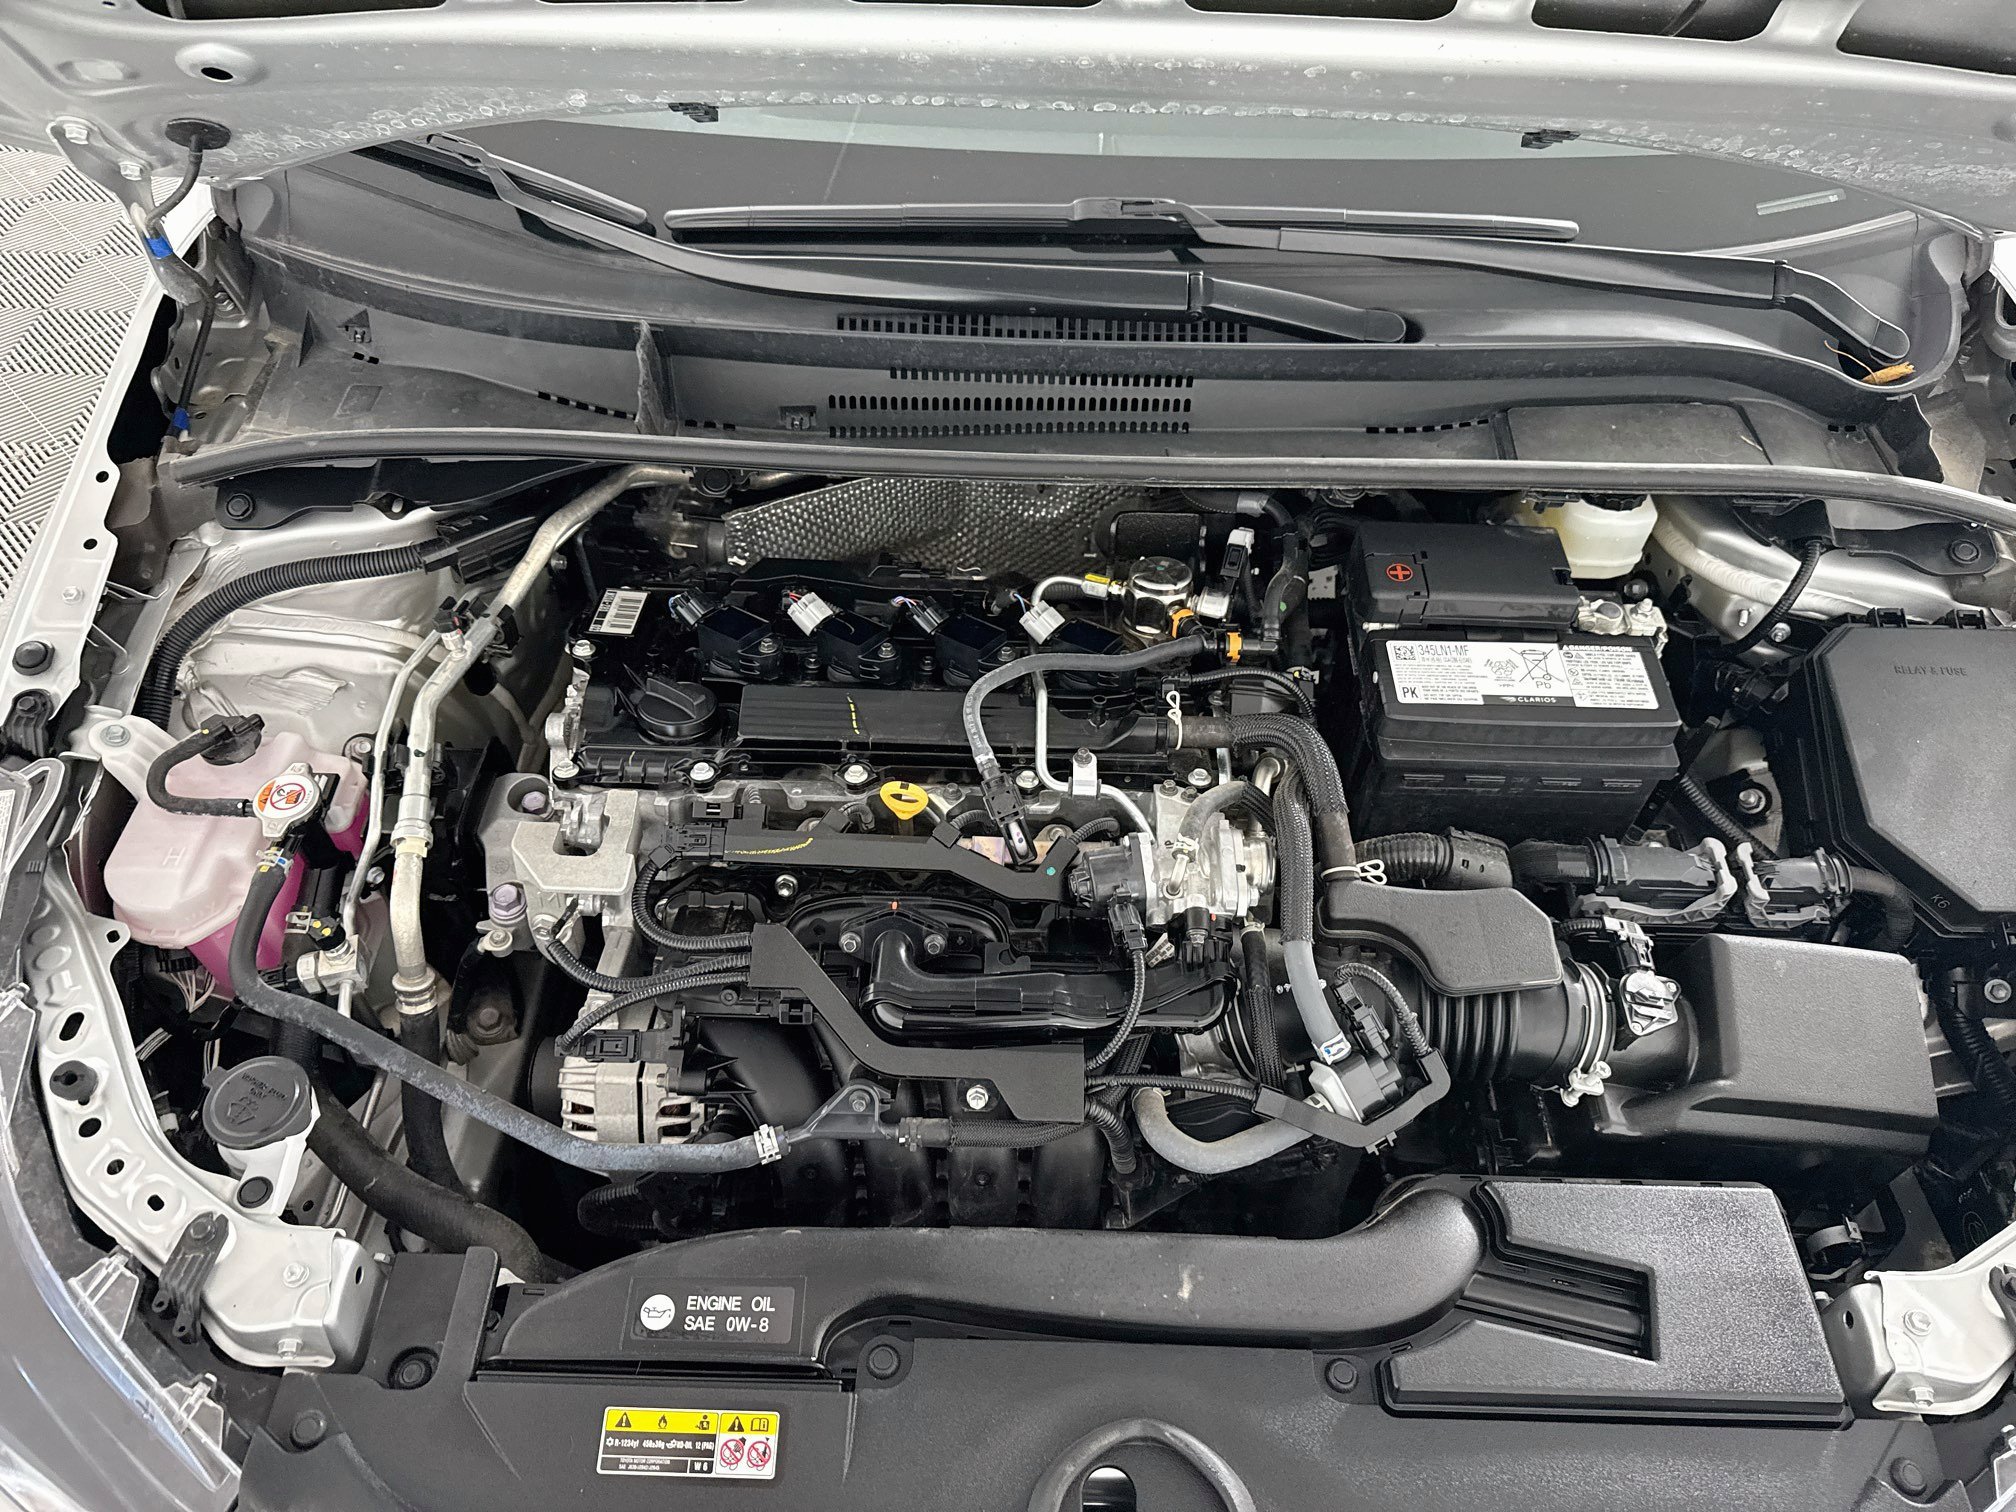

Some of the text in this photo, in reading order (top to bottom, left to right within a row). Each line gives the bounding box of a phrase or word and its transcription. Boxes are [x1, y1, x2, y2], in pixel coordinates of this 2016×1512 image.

[1418, 644, 1469, 656] 345LN1-MF
[1894, 665, 1968, 676] RELAY & FUSE
[1536, 681, 1551, 689] Pb
[1402, 686, 1419, 698] PK
[1517, 696, 1557, 704] CLARIOS
[686, 1295, 776, 1312] ENGINE OIL
[684, 1316, 769, 1332] SAE 0W-8
[694, 1462, 701, 1470] W
